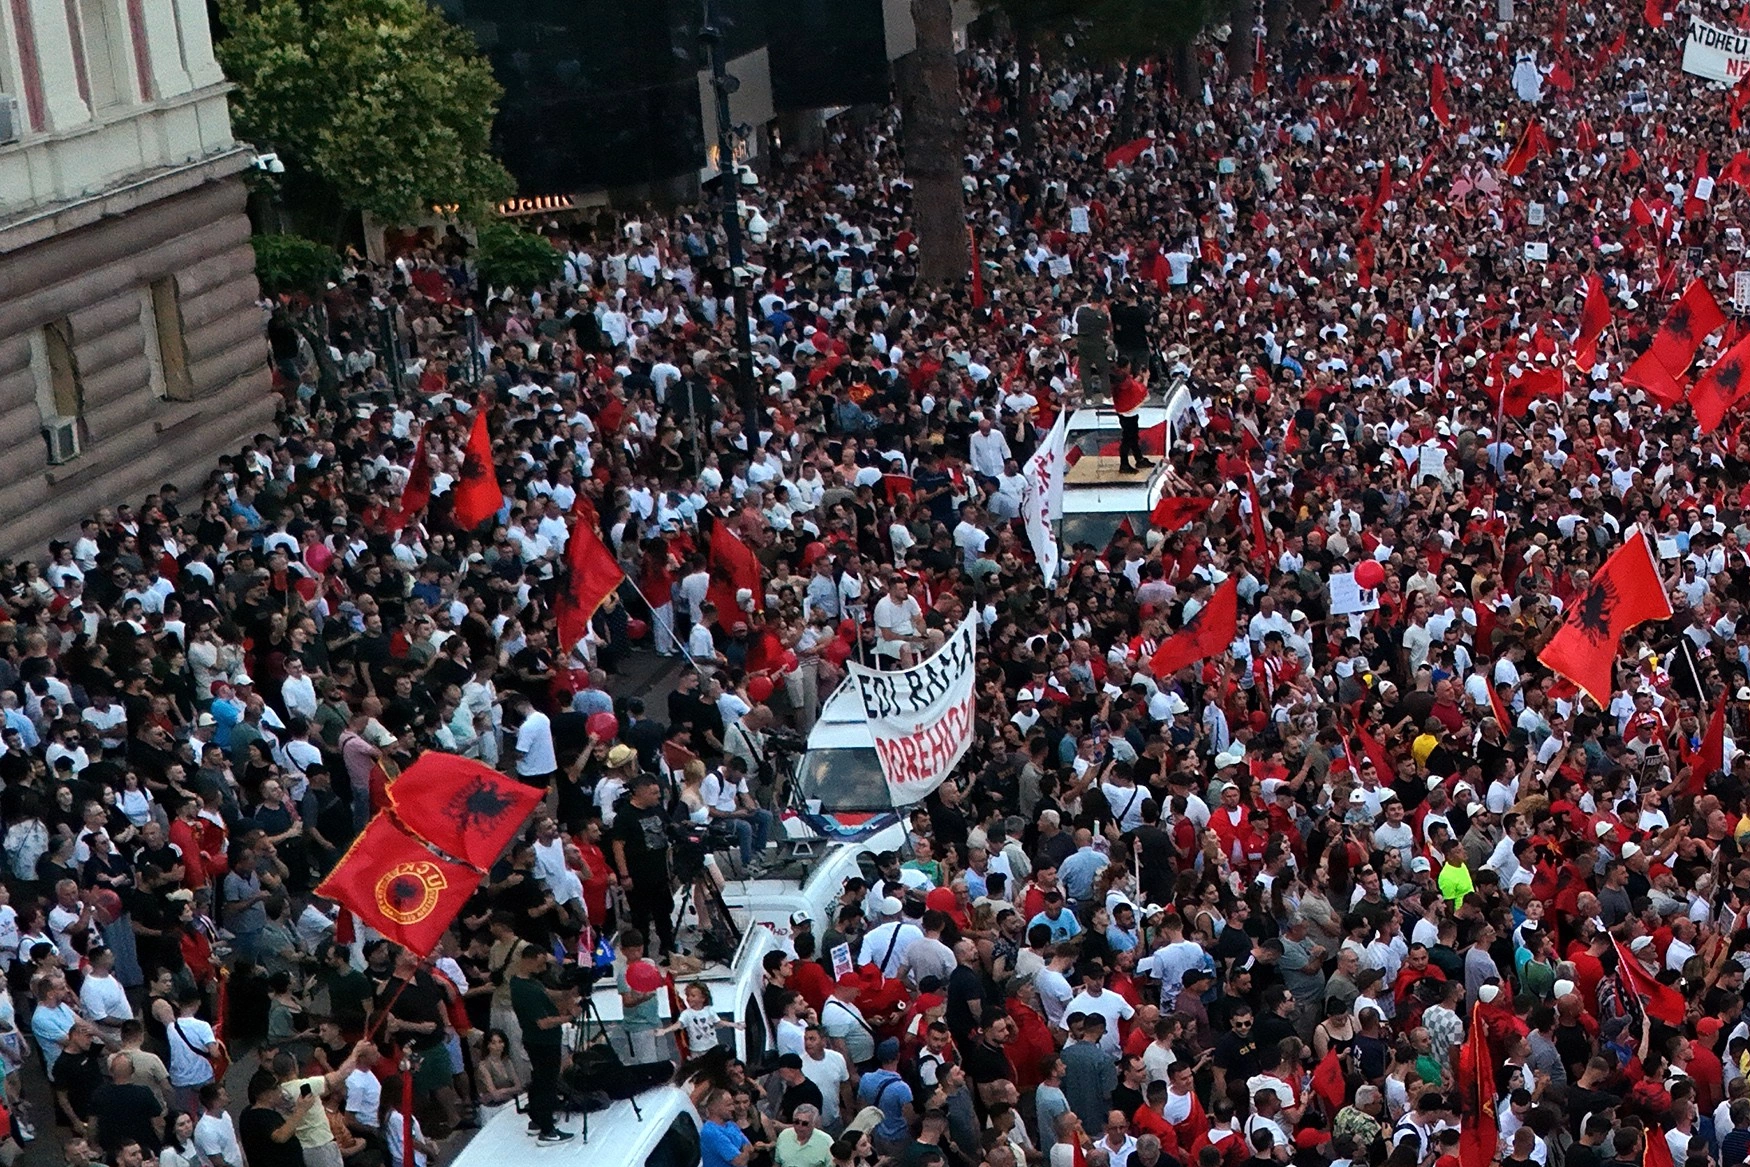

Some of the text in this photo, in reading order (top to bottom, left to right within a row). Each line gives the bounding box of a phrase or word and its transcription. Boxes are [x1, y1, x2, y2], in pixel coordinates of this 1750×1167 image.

[1688, 22, 1748, 54] ATDHEU
[856, 628, 975, 719] EDI RAMA
